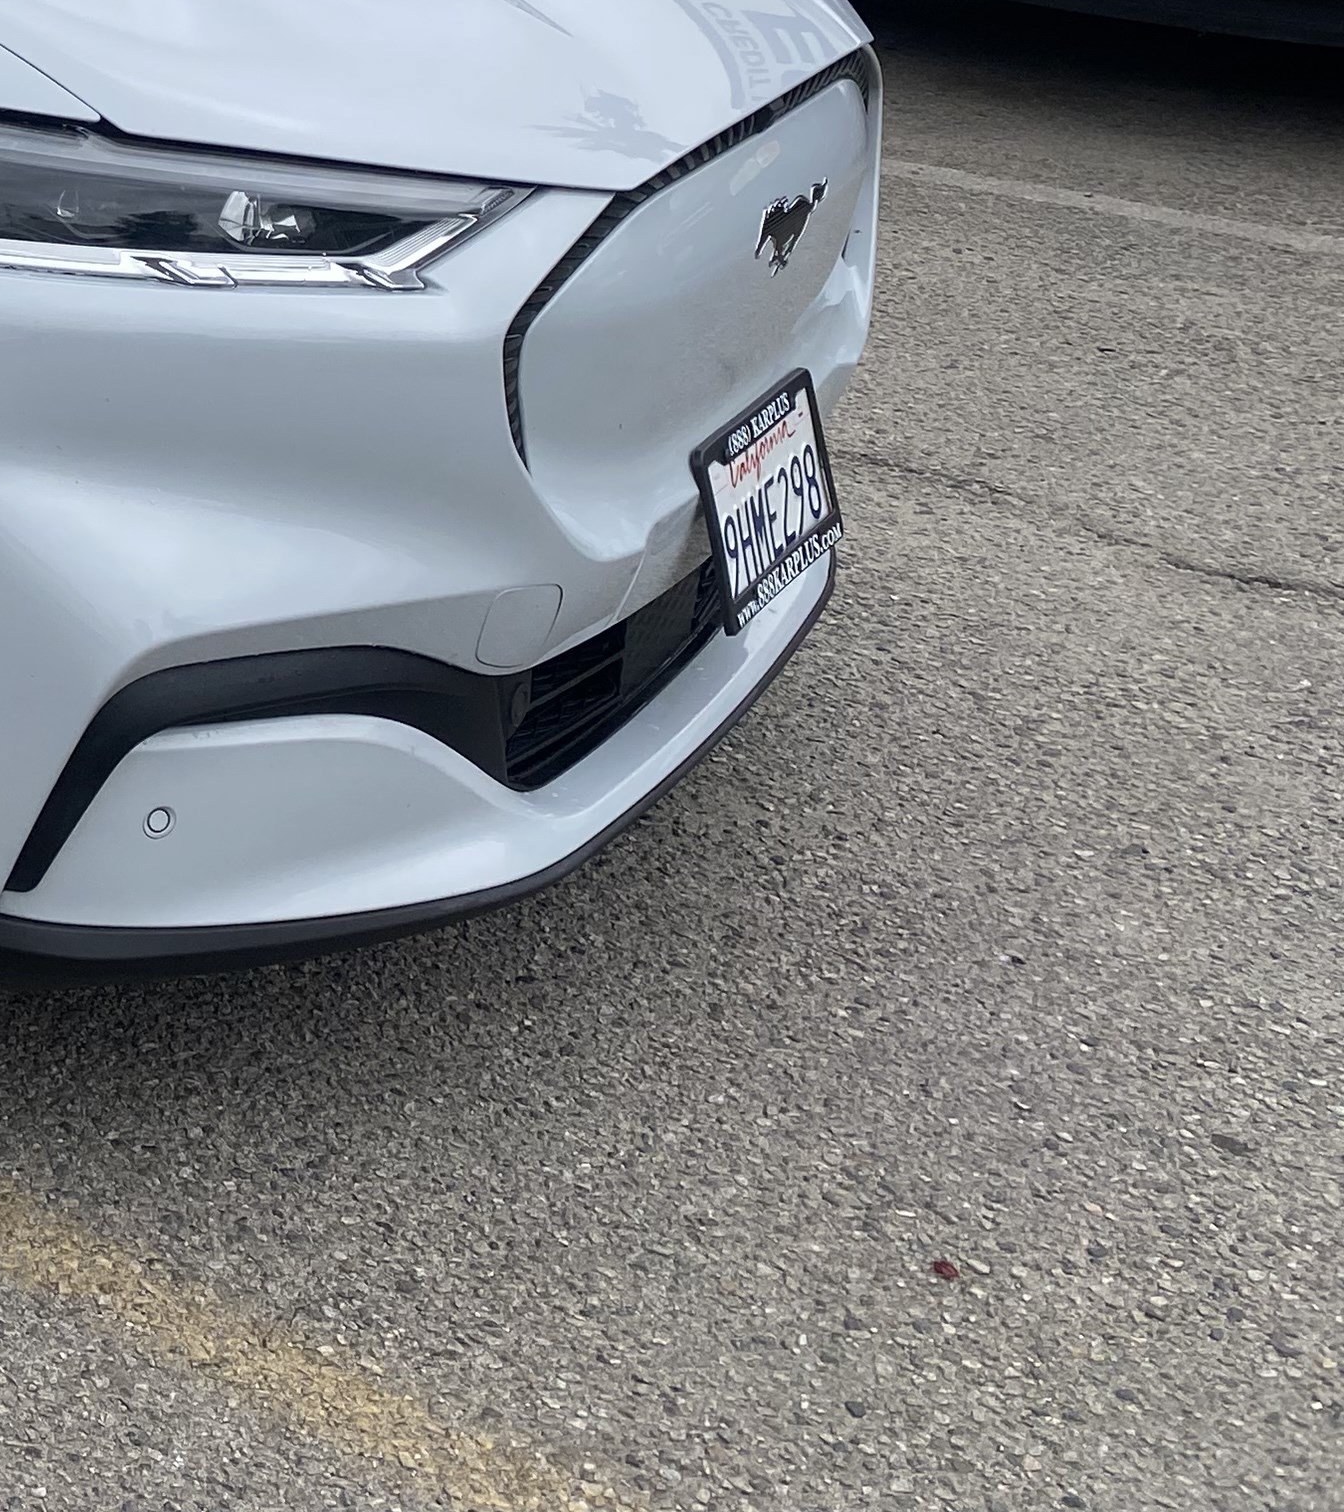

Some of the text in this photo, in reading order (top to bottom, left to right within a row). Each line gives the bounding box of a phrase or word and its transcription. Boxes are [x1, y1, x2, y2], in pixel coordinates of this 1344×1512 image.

[727, 392, 790, 454] (888) KARPLUS
[725, 444, 822, 599] 9HME298
